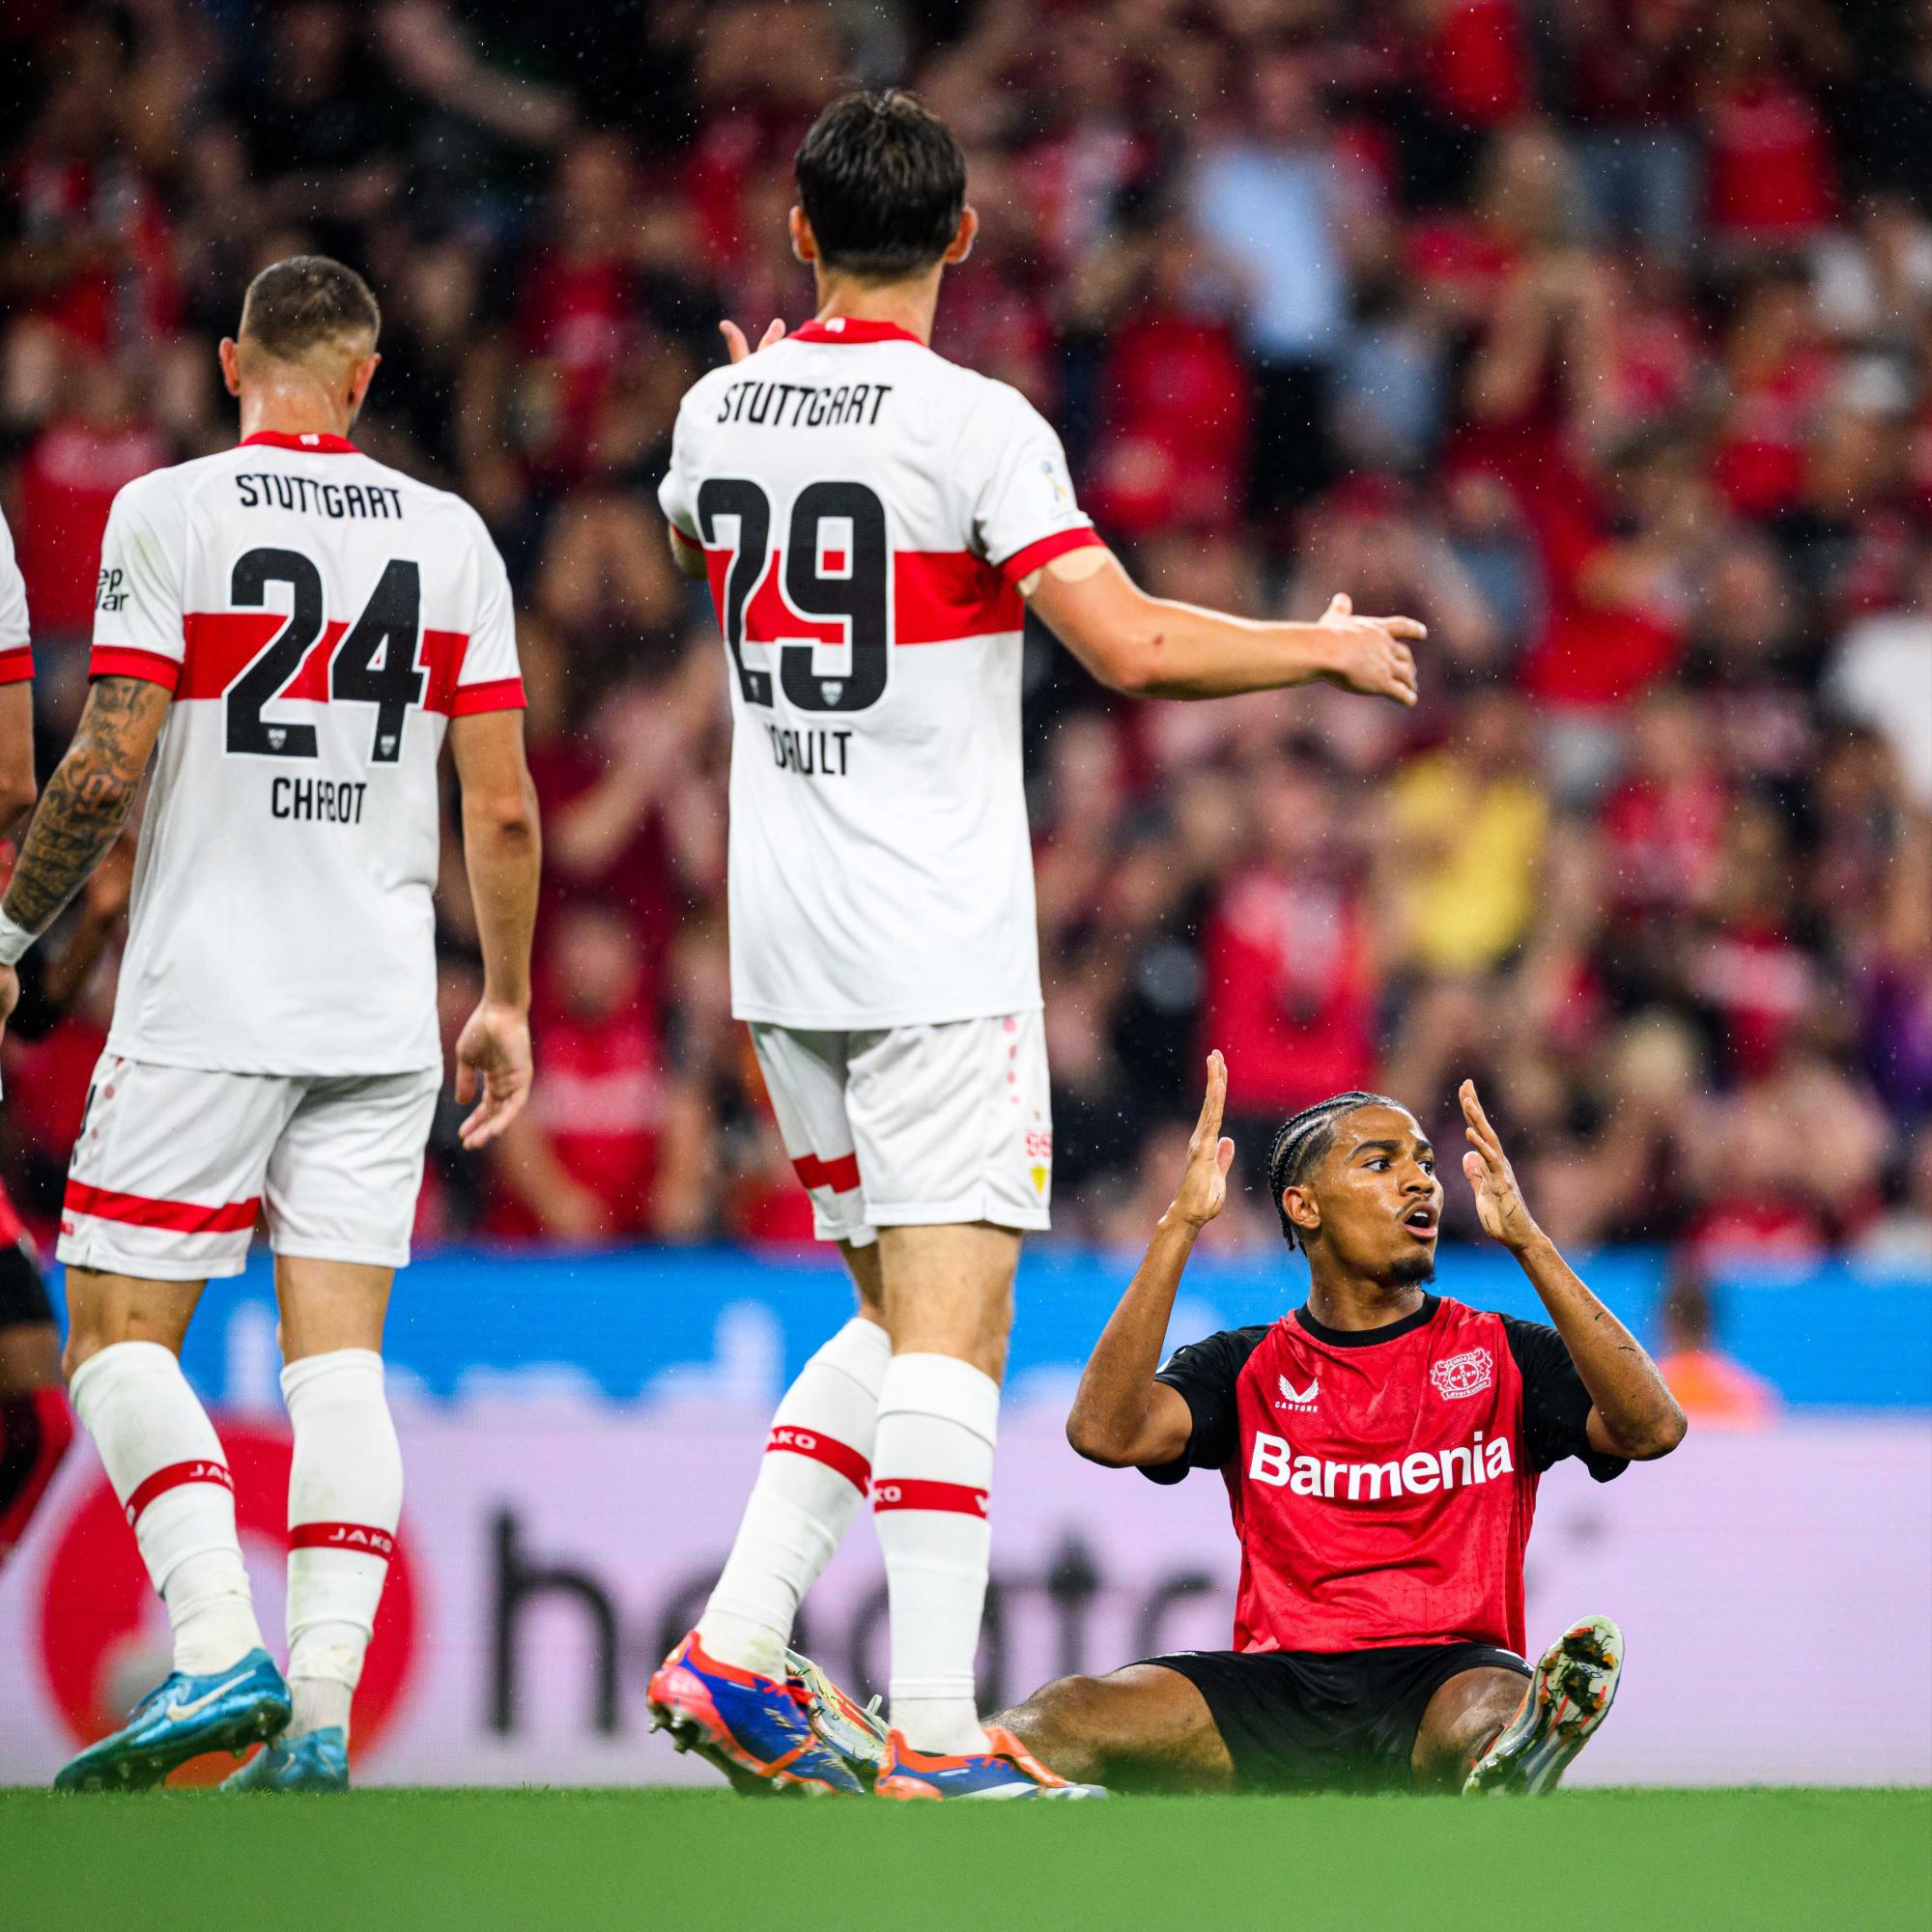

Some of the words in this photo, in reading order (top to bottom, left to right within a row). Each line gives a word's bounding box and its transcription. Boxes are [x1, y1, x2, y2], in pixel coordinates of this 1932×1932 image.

[718, 383, 893, 427] STUTTGART
[236, 474, 402, 519] STUTTGART
[99, 568, 123, 592] ep
[697, 479, 888, 712] 29
[226, 548, 424, 762] 24
[1275, 1401, 1318, 1412] CASTORE
[767, 1430, 817, 1449] AKO
[189, 1463, 234, 1487] JAK
[1249, 1431, 1515, 1500] Barmenia
[874, 1486, 901, 1502] KO
[328, 1527, 392, 1553] JAKO
